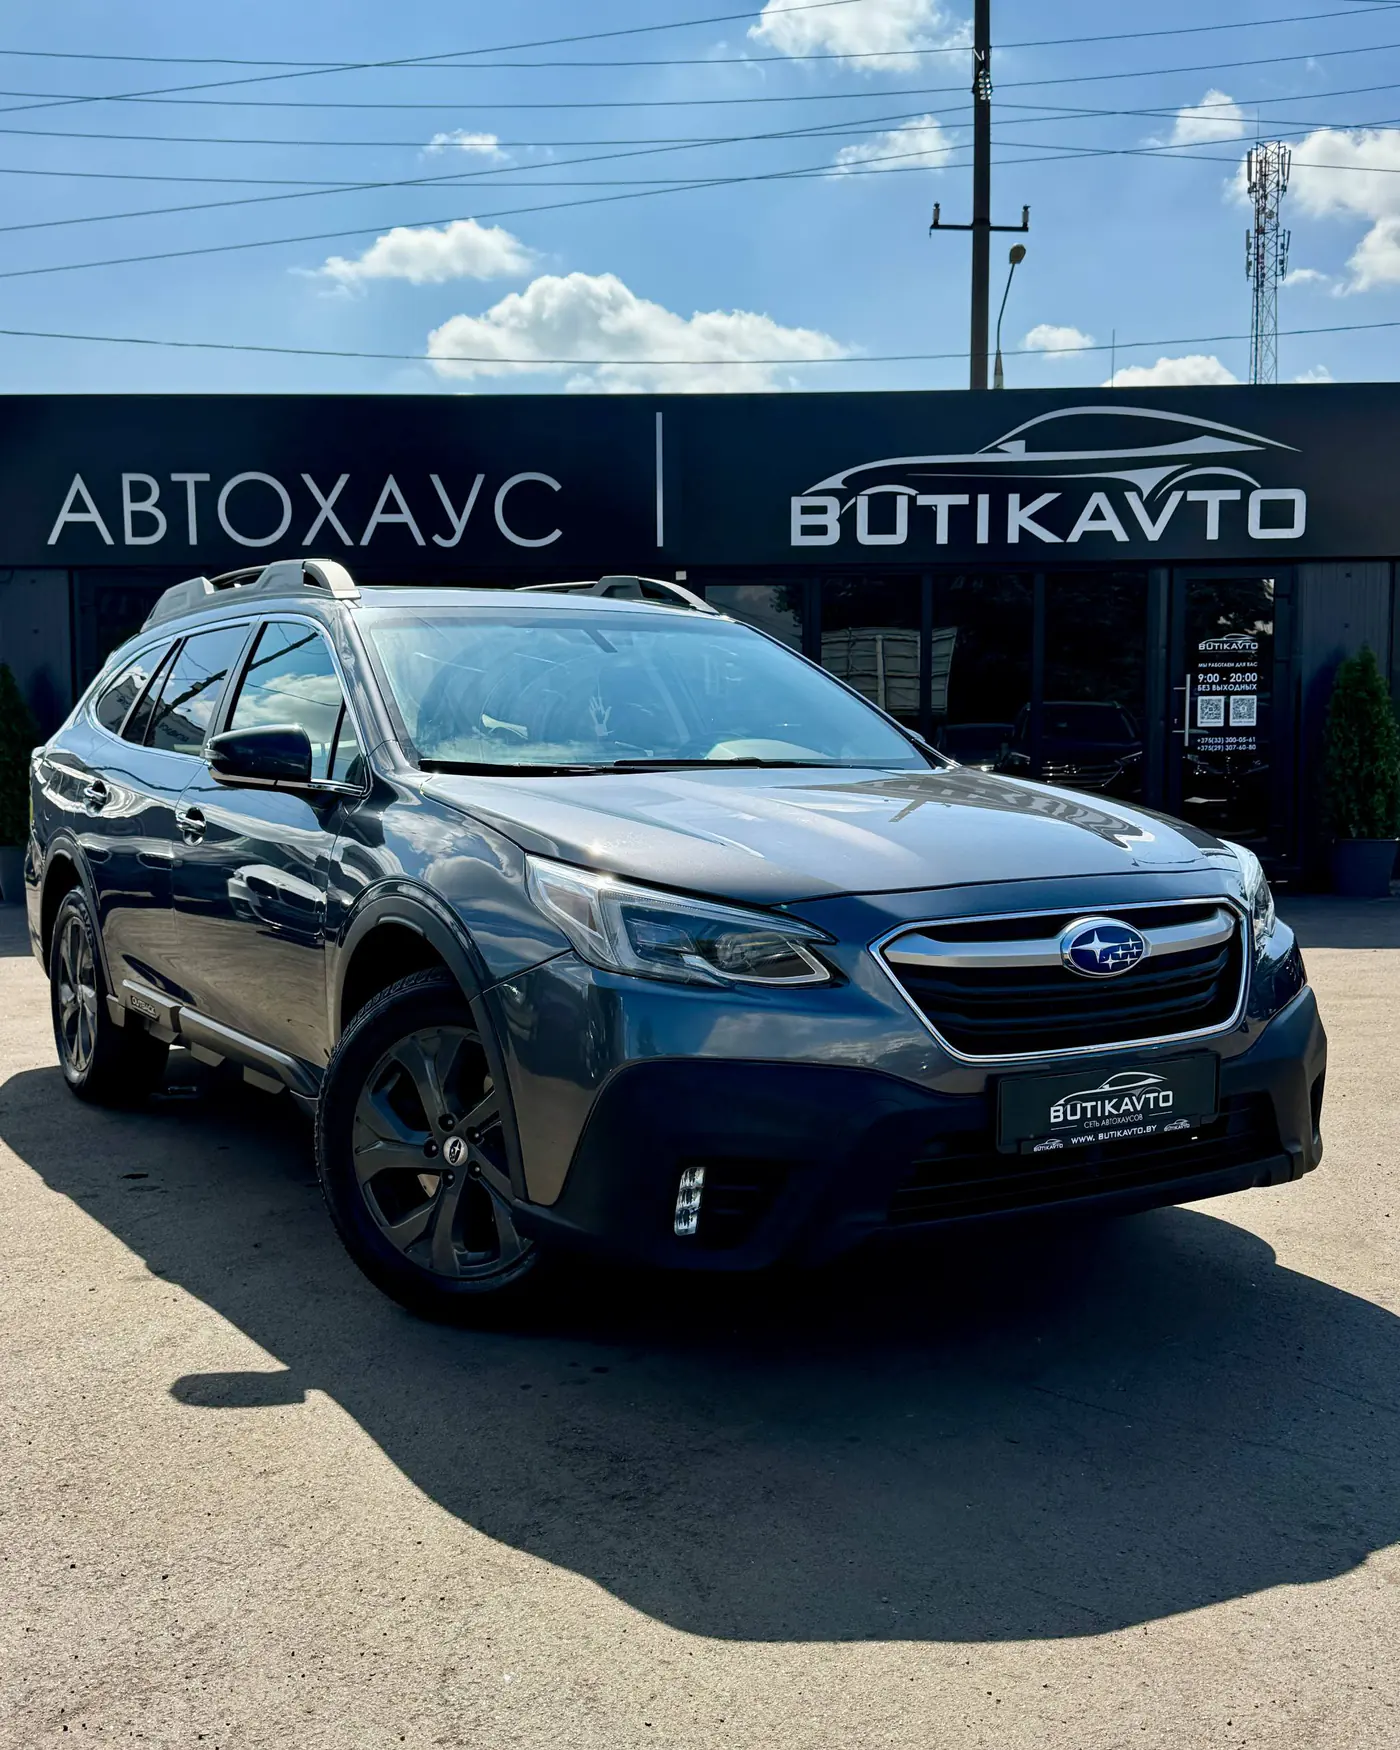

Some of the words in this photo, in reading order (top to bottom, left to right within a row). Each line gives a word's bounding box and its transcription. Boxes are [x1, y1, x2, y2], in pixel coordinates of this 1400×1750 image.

[47, 471, 562, 548] АВТОХАУС
[790, 487, 1306, 546] BUTIKAVTO
[1197, 684, 1210, 692] БЕЗ
[1211, 683, 1257, 691] ВЫХОДНЫХ
[1198, 673, 1220, 683] 9:00
[1229, 672, 1258, 682] 20:00
[1050, 1090, 1173, 1123] BUTIKAVTO
[1071, 1134, 1096, 1145] WWW.
[1098, 1124, 1157, 1140] BUTIKAVTO.BY
